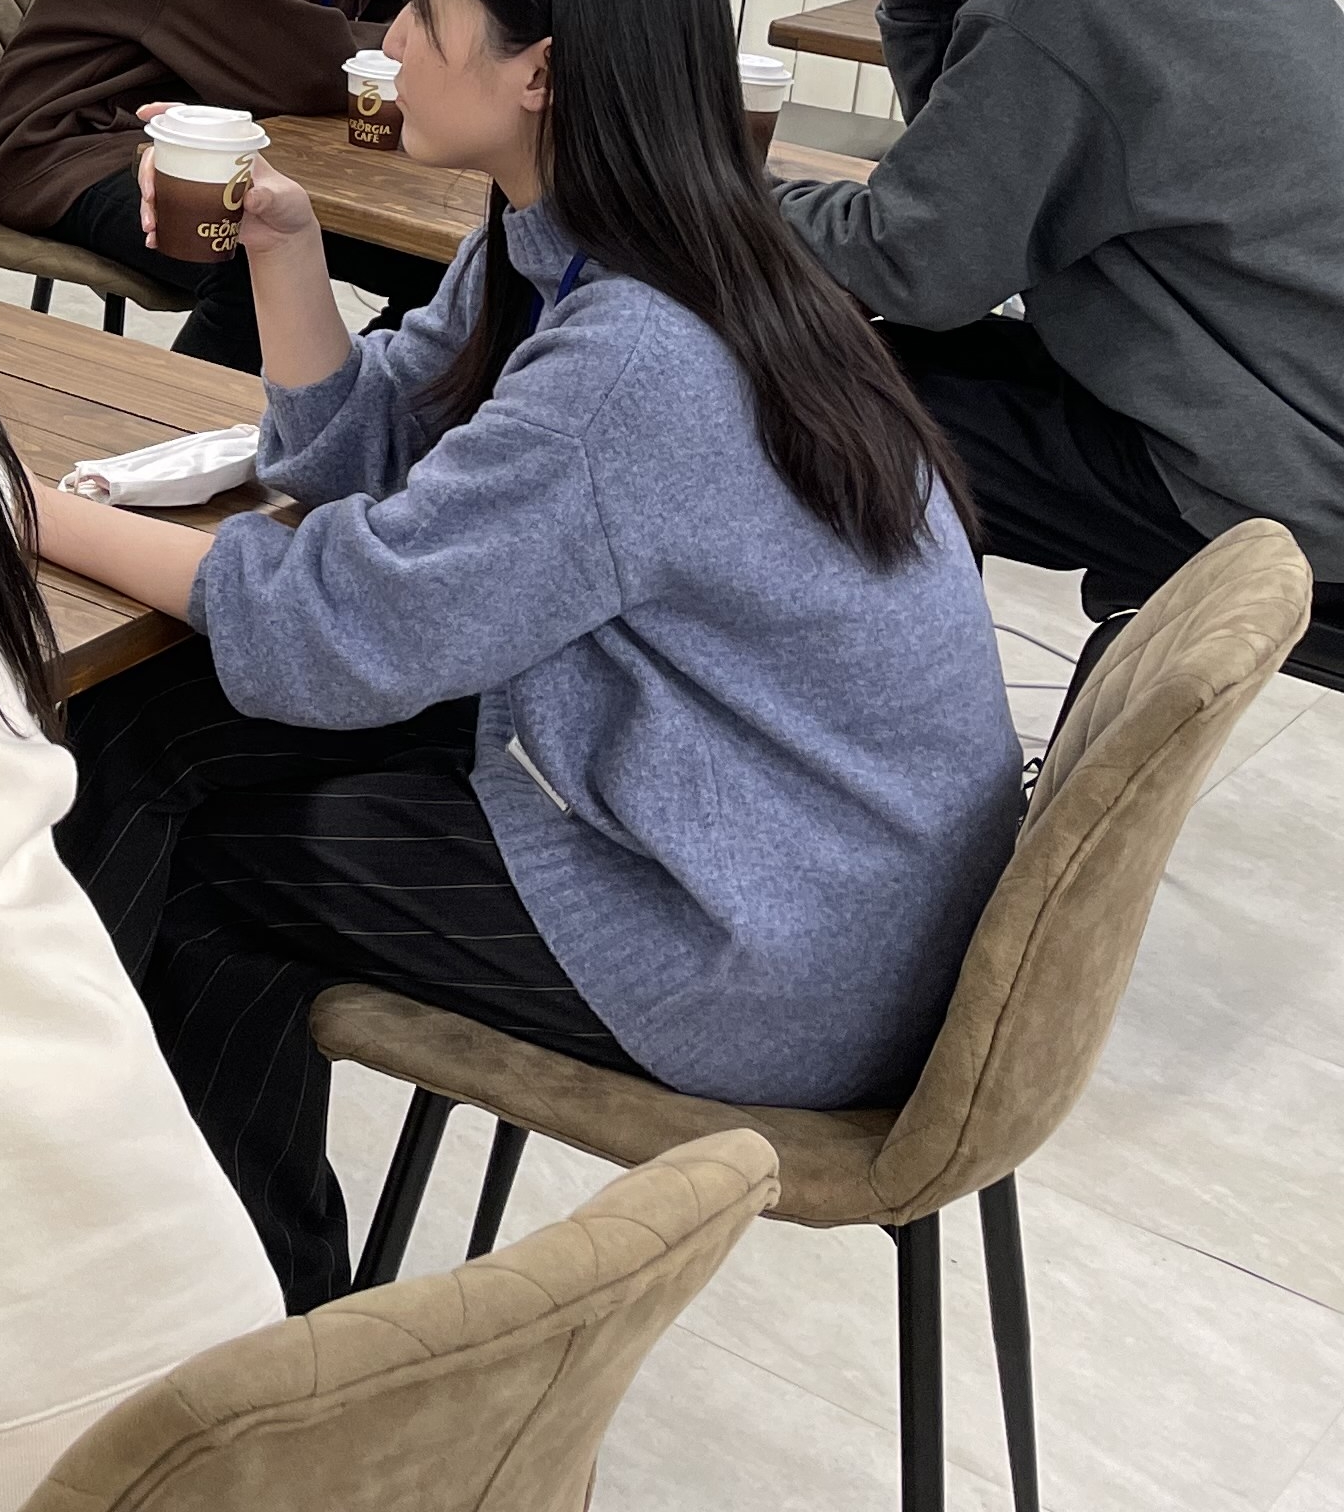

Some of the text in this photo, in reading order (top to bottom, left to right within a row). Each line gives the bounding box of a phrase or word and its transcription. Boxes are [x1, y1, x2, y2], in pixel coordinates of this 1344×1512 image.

[354, 130, 379, 143] CAFE
[197, 218, 241, 238] GEOR
[212, 237, 238, 252] CAF
